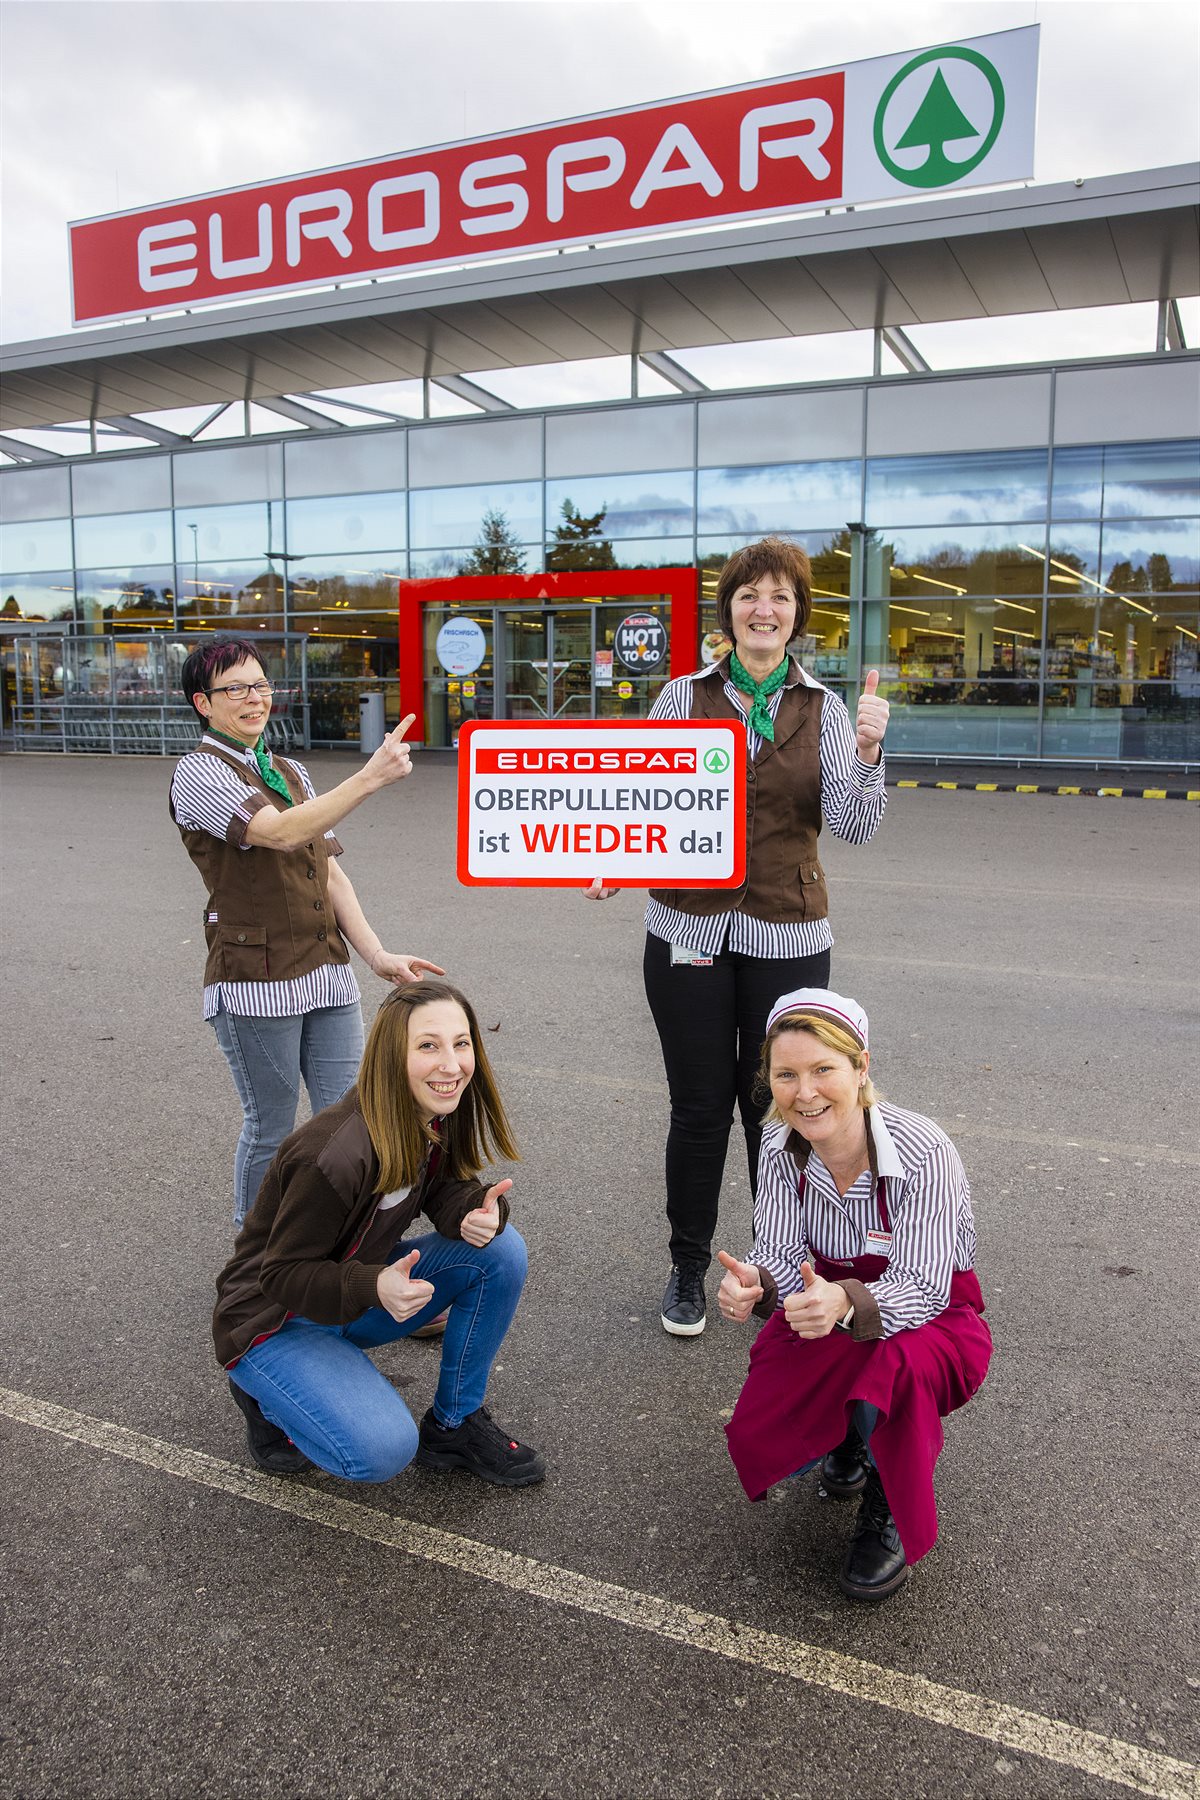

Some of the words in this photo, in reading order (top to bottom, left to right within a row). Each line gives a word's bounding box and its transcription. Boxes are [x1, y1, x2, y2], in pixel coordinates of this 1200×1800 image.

[137, 96, 834, 293] EUROSPAR
[622, 629, 661, 646] HOT
[622, 650, 639, 662] TO
[642, 650, 660, 662] GO
[497, 752, 695, 770] EUROSPAR
[474, 788, 730, 811] OBERPULLENDORF
[478, 829, 510, 854] ist
[520, 823, 668, 854] WIEDER
[679, 829, 723, 854] da!
